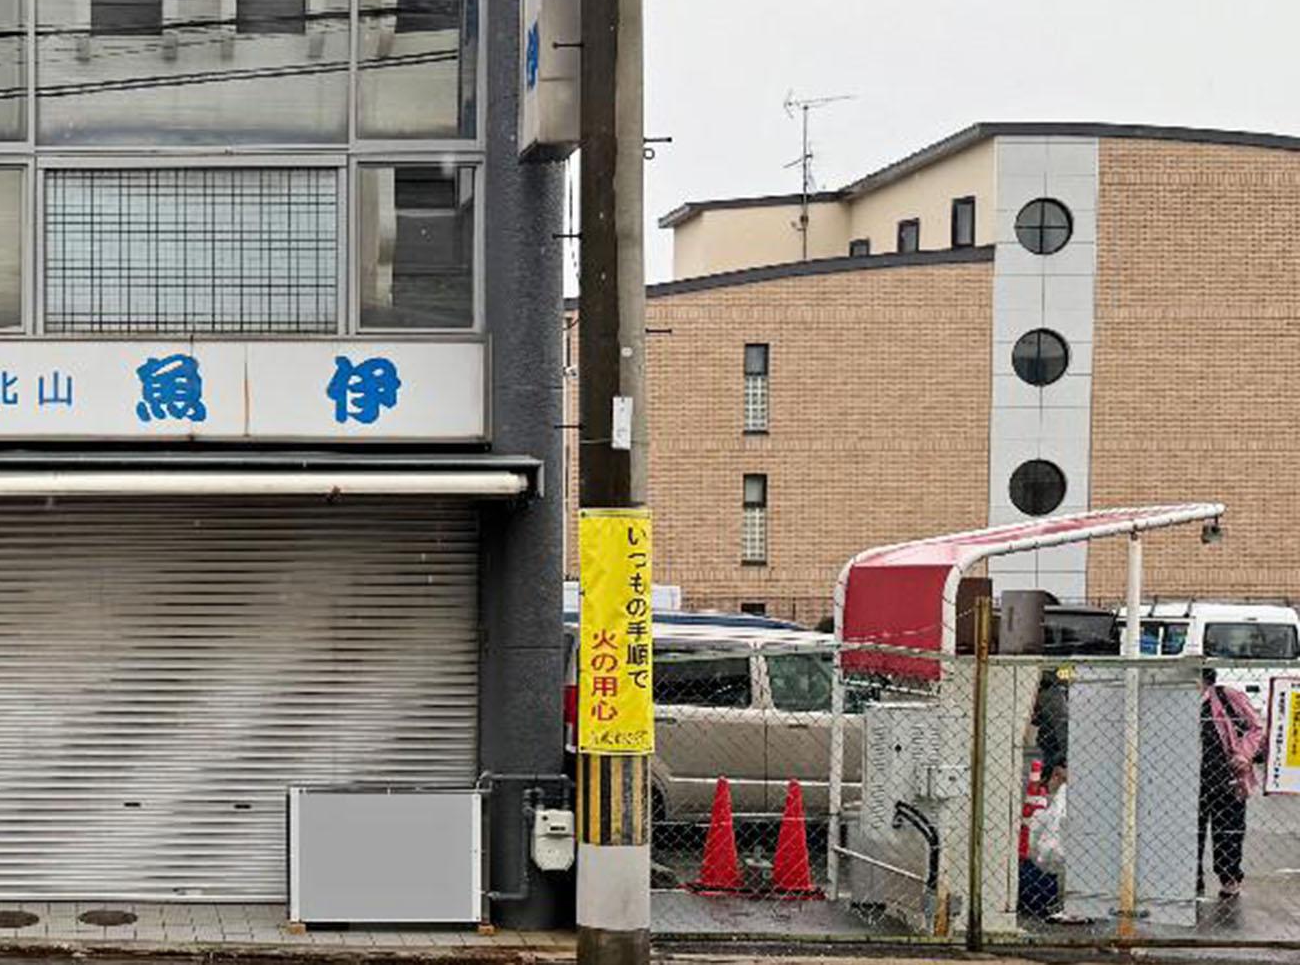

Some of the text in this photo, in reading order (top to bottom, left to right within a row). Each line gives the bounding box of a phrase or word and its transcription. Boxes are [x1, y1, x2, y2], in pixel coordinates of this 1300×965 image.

[135, 353, 402, 423] 魚伊
[626, 526, 649, 689] いつもの手順で
[591, 628, 619, 721] 火の用心
